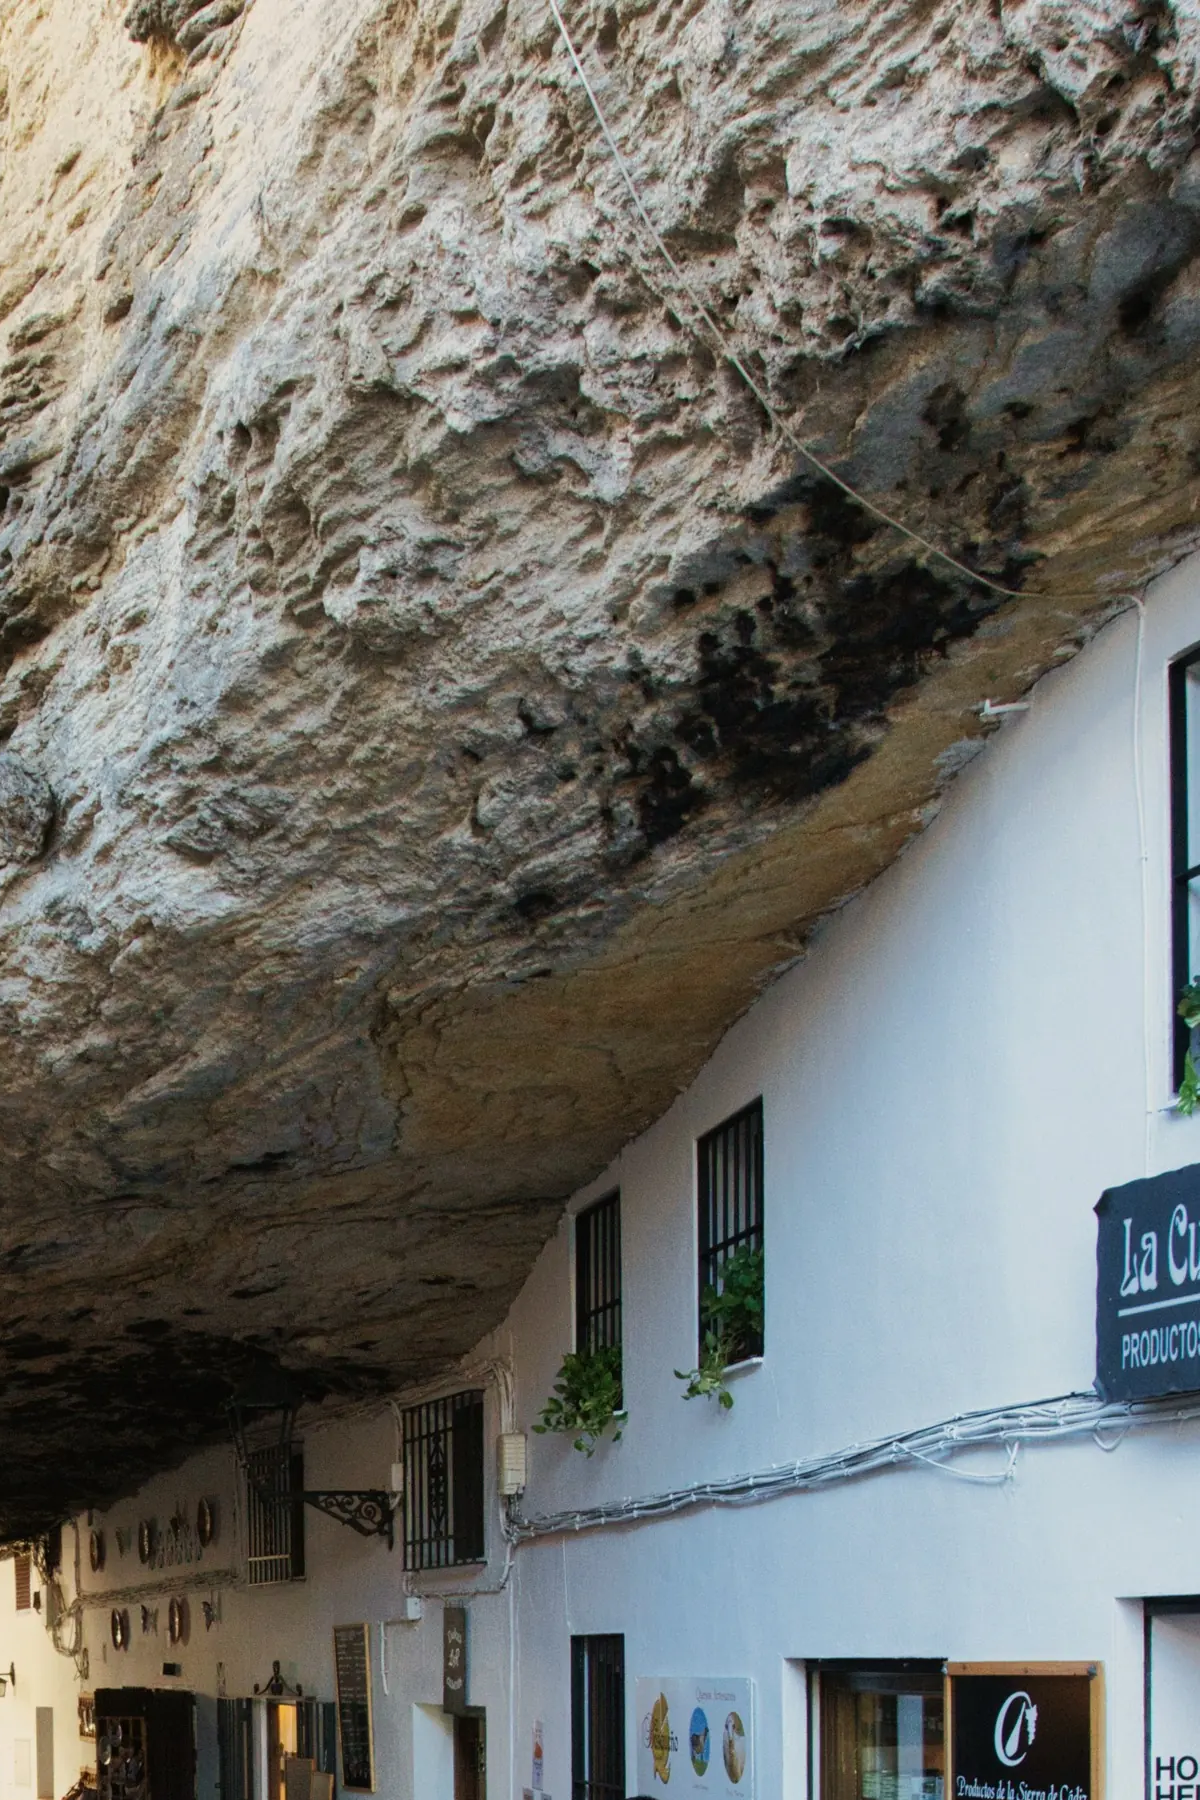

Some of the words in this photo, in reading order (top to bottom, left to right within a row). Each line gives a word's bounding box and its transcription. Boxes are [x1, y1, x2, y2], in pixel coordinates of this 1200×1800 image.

[1120, 1217, 1158, 1297] La
[1122, 1320, 1200, 1370] PRODUCTO
[957, 1775, 995, 1799] Productos
[996, 1780, 1006, 1800] de
[1007, 1780, 1015, 1800] la
